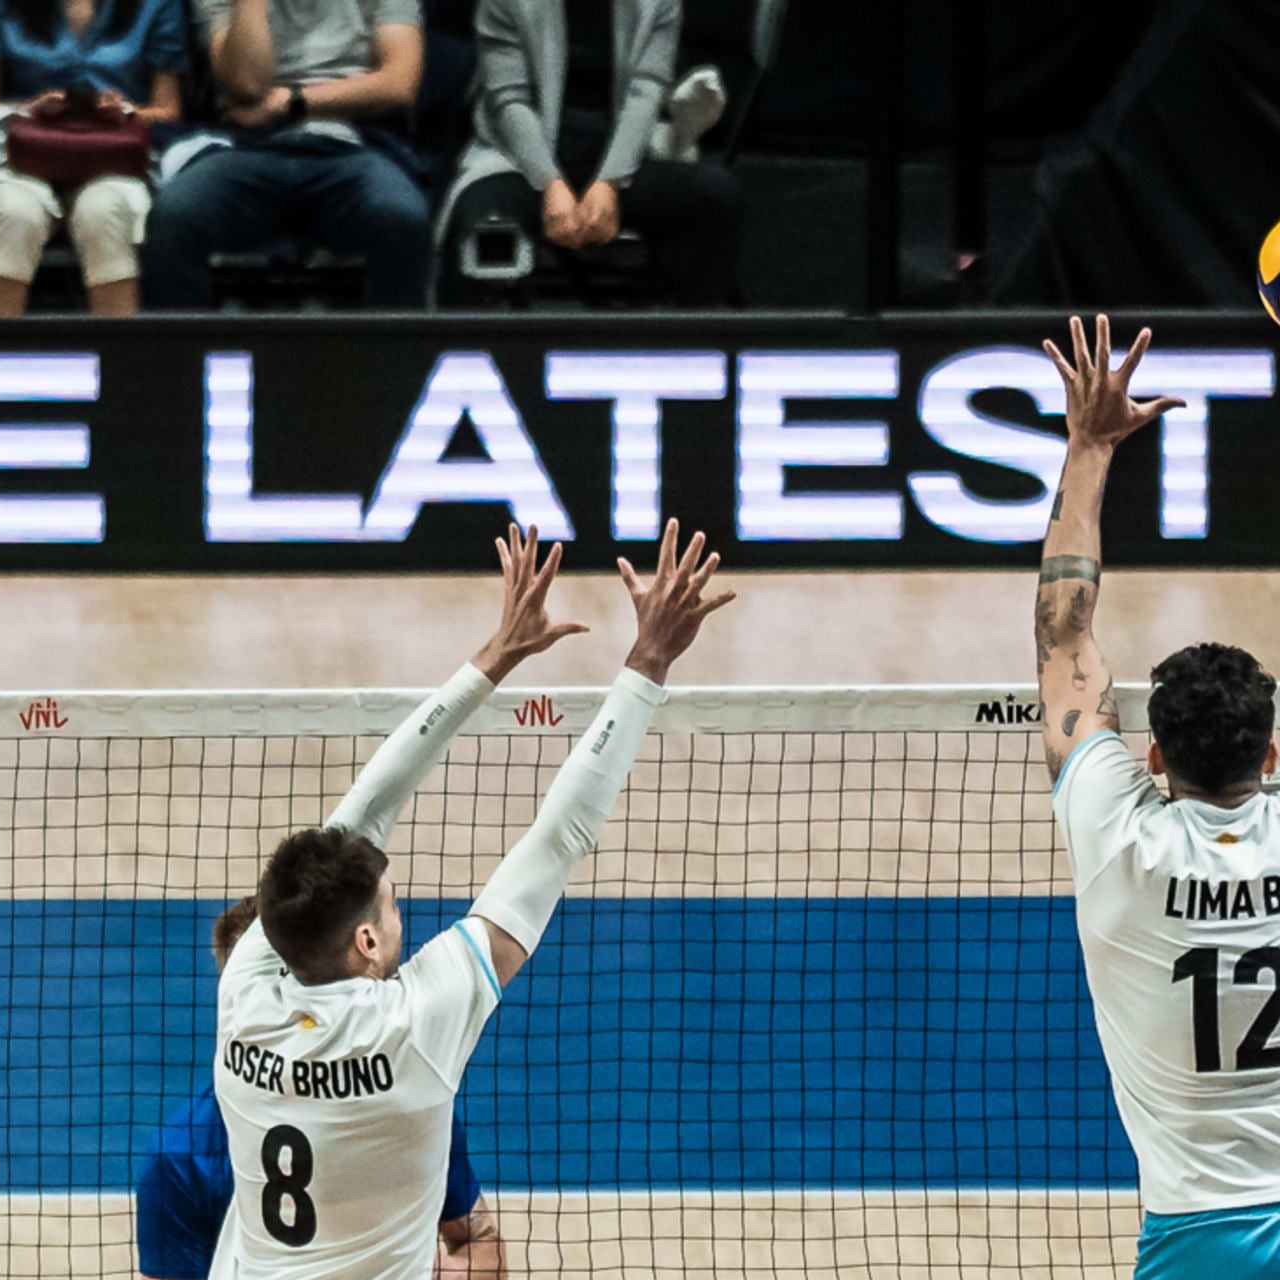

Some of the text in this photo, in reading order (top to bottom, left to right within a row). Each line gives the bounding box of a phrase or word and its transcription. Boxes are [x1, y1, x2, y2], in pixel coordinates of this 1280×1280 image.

[204, 345, 1276, 545] LATEST
[19, 697, 69, 730] VNL
[513, 694, 564, 727] VNL
[1165, 876, 1257, 920] LIMA
[292, 1052, 394, 1099] BRUNO
[260, 1123, 318, 1248] 8
